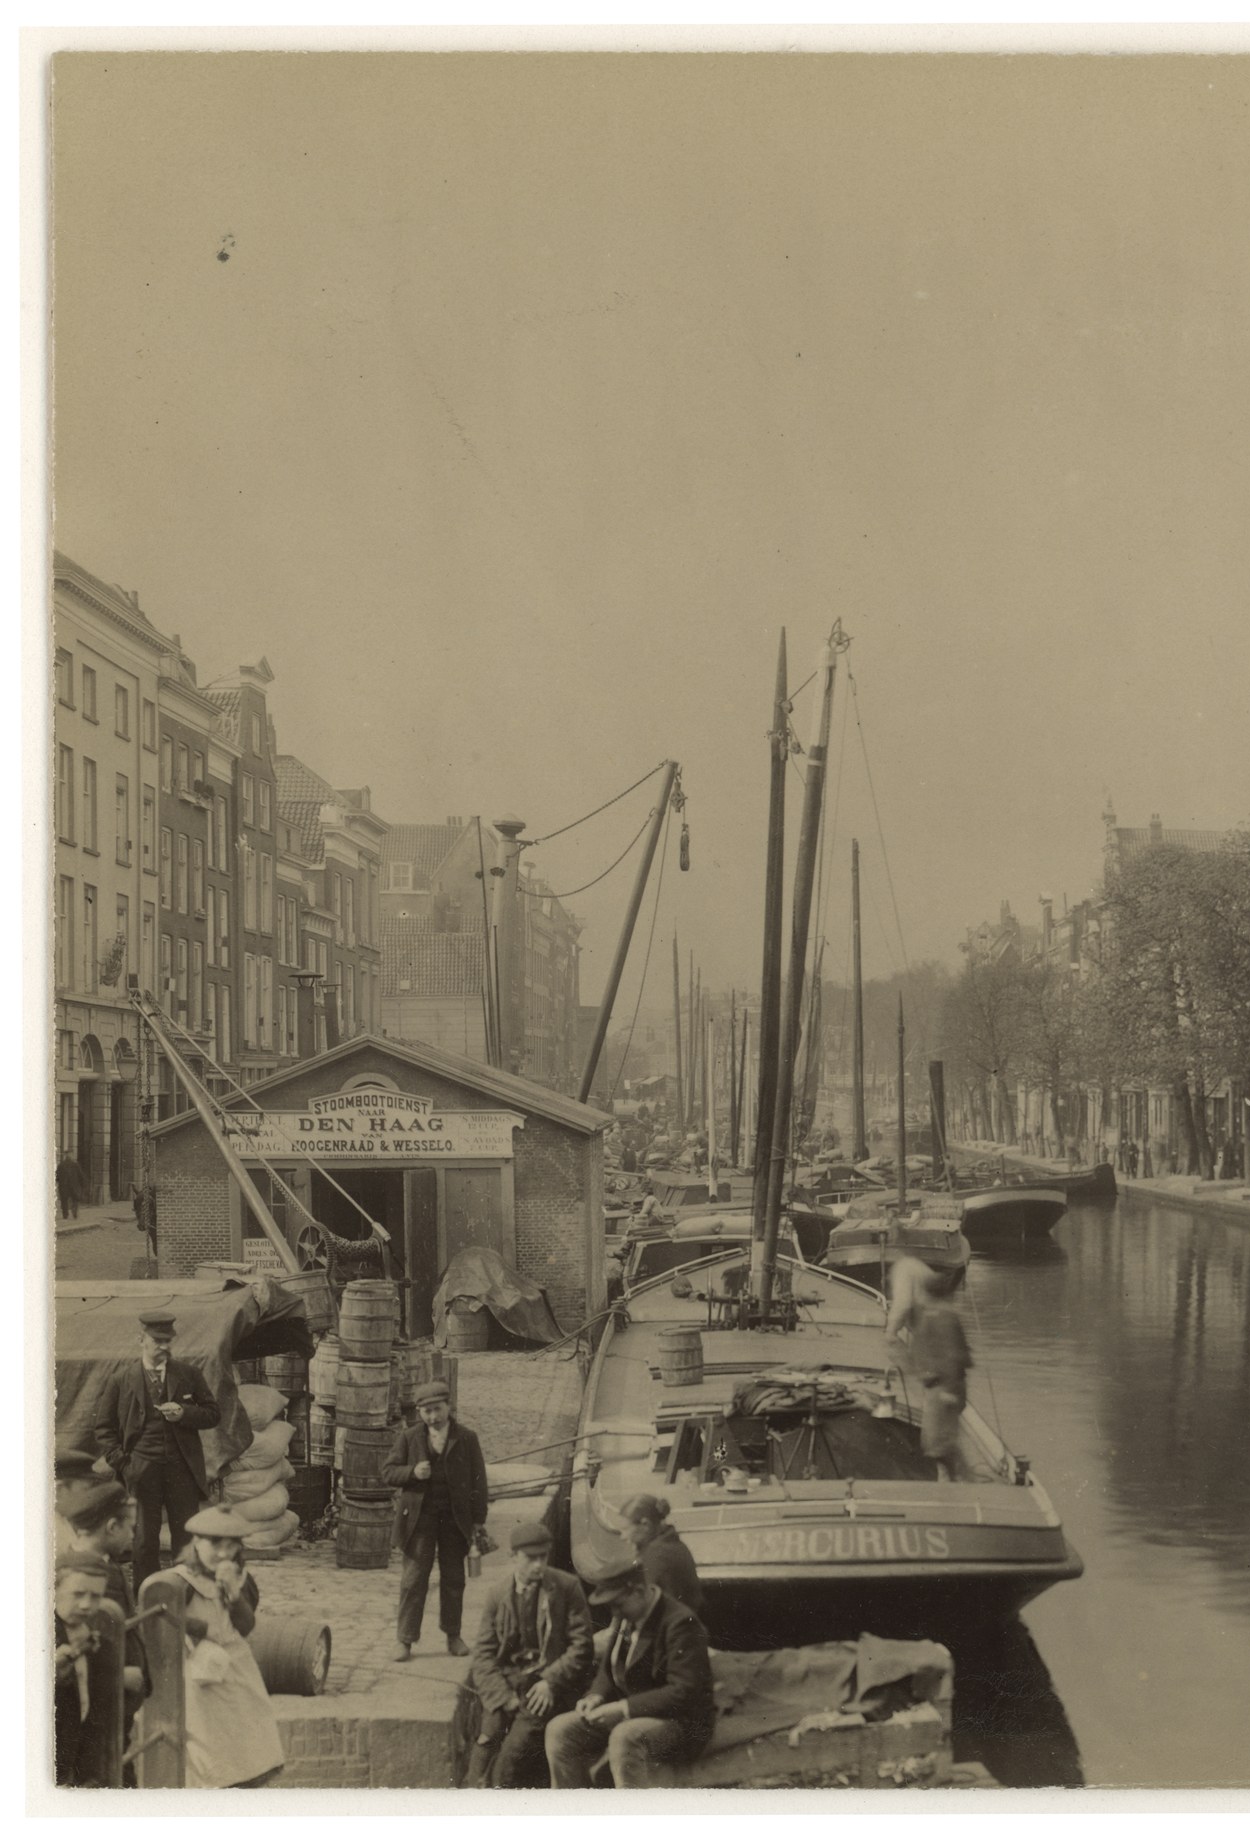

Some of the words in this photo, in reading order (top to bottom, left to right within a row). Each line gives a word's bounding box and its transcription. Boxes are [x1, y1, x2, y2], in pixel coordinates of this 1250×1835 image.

[314, 1094, 428, 1115] STOOMBOOTDIENST
[357, 1109, 386, 1117] NAAR
[298, 1117, 354, 1132] DEN
[369, 1117, 444, 1133] HAAG
[291, 1139, 374, 1152] HOOGENRAAD
[379, 1139, 390, 1152] &
[245, 1240, 272, 1248] GESLOTE
[735, 1526, 951, 1561] MERCURIUS
